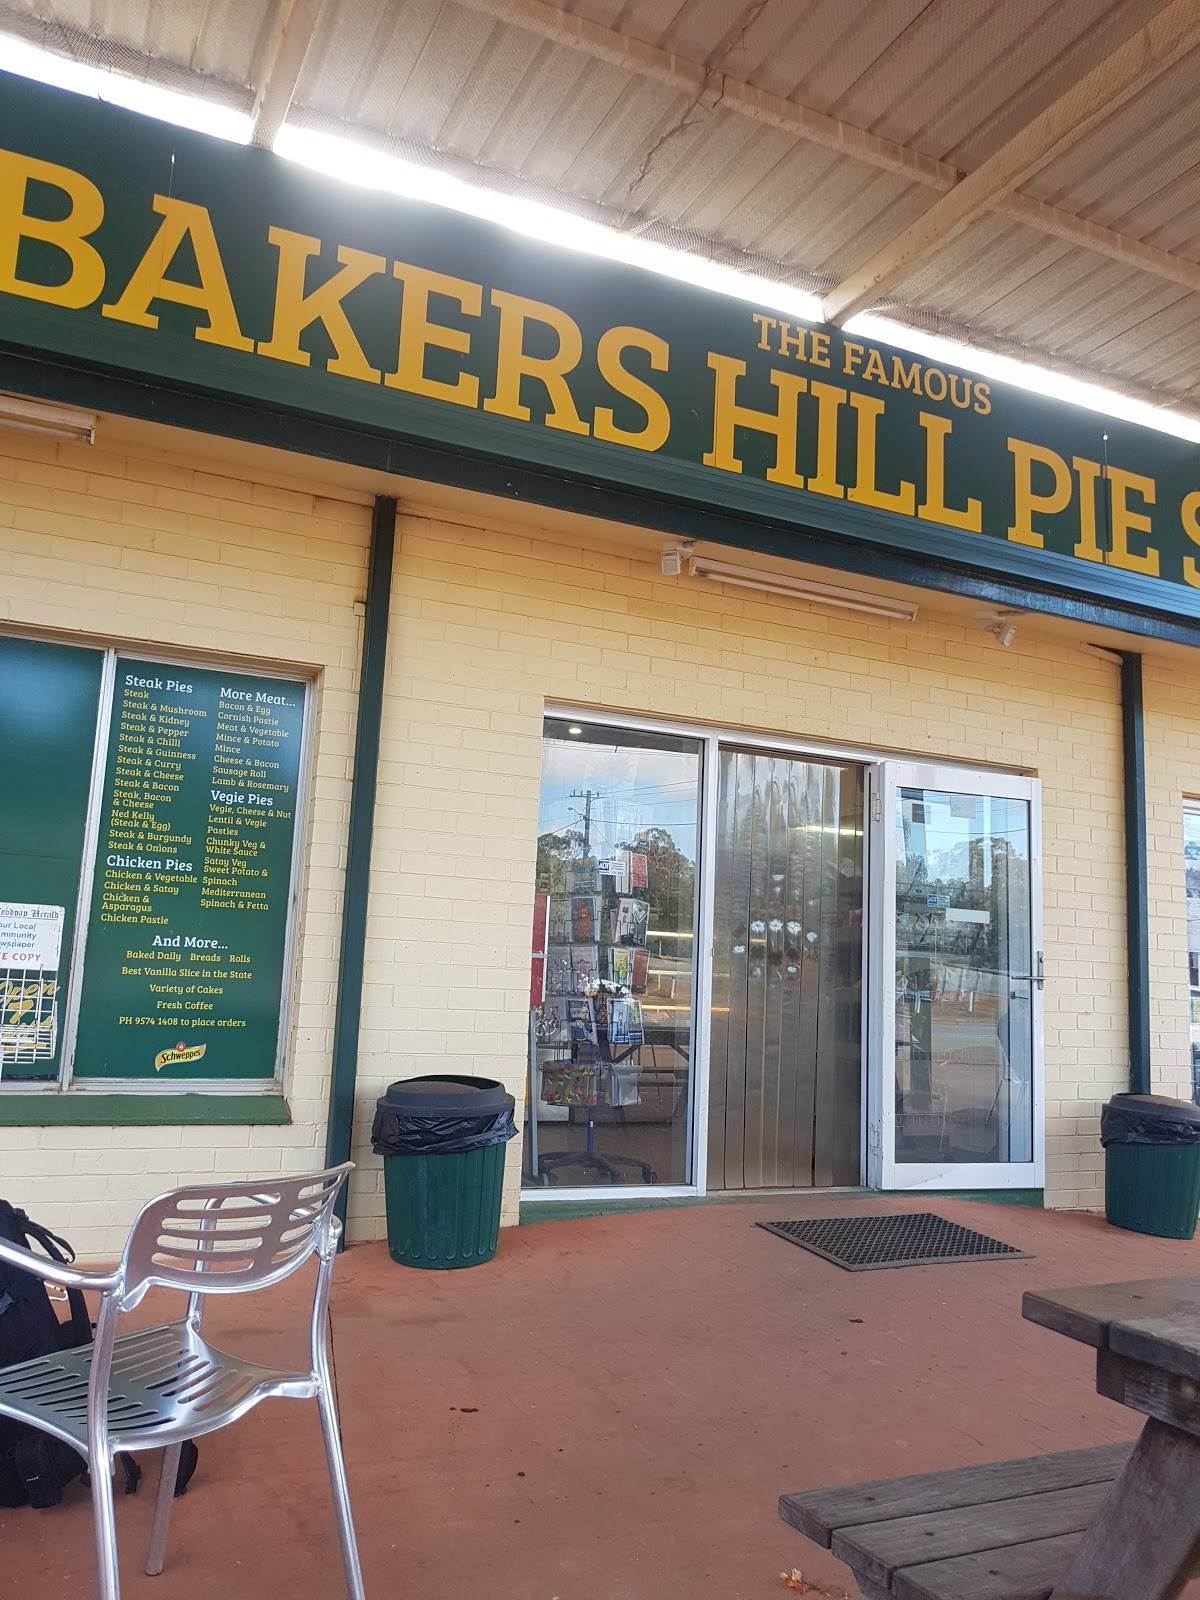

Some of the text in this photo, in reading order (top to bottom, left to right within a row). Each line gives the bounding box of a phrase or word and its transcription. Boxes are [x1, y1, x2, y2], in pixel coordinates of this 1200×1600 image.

[0, 149, 671, 452] BAKERS
[702, 352, 983, 534] HILL
[1006, 438, 1160, 577] PIE
[752, 313, 992, 415] THE FAMOUS
[125, 675, 193, 693] Steak Pies
[124, 689, 150, 699] Steak
[220, 688, 296, 707] More Meat...
[123, 700, 148, 710] Steak
[160, 705, 207, 717] Mushroom
[219, 701, 271, 715] Bacon & Egg
[122, 711, 190, 727] Steak & Kidney
[218, 712, 279, 725] Cornish Pastie
[120, 722, 146, 732] Steak
[158, 727, 189, 737] Pepper
[217, 723, 238, 732] Meat
[249, 726, 289, 738] Vegetable
[120, 734, 145, 744] Steak
[156, 738, 181, 747] Chilli
[216, 734, 242, 743] Mince
[252, 738, 279, 747] Potato
[118, 745, 144, 755] Steak
[155, 749, 197, 760] Guinness
[215, 744, 241, 754] Mince
[117, 756, 142, 766] Steak
[154, 760, 182, 771] Curry
[214, 755, 280, 769] Cheese & Bacon
[116, 767, 184, 781] Steak & Cheese
[213, 766, 266, 778] Sausage Roll
[115, 779, 140, 789] Steak
[152, 782, 180, 791] Bacon
[212, 777, 236, 786] Lamb
[248, 781, 289, 793] Rosemary
[114, 790, 172, 802] Steak, Bacon
[211, 790, 273, 806] Vegie Pies
[113, 798, 154, 809] & Cheese
[112, 810, 155, 822] Ned Kelly
[210, 804, 234, 815] Vegie,
[237, 808, 266, 816] Cheese
[110, 818, 139, 828] (Steak
[151, 821, 171, 832] Egg)
[208, 816, 233, 824] Lentil
[245, 818, 267, 828] Vegie
[109, 830, 192, 844] Steak & Burgundy
[208, 826, 238, 836] Pasties
[108, 841, 134, 850] Steak
[146, 844, 178, 853] Onions
[206, 837, 240, 848] Chunky
[242, 840, 257, 850] Veg
[206, 846, 258, 856] White Sauce
[107, 855, 193, 871] Chicken Pies
[204, 857, 247, 868] Satay Veg
[105, 870, 142, 880] Chicken
[155, 873, 198, 884] Vegetable
[204, 866, 229, 874] Sweet
[231, 867, 260, 876] Potato
[203, 877, 238, 886] Spinach
[104, 881, 141, 891] Chicken
[153, 884, 179, 895] Satay
[202, 888, 266, 899] Mediterranean
[103, 893, 140, 902] Chicken
[102, 902, 152, 913] Asparagus
[200, 899, 269, 910] Spinach & Fetta
[101, 914, 169, 924] Chicken Pastie
[14, 922, 36, 930] Local
[152, 935, 228, 949] And More...
[12, 953, 41, 961] COPY
[126, 951, 251, 963] Baked Daily Breads Rolls
[122, 967, 252, 979] Best Vanilla Slice in the State
[149, 984, 223, 994] Variety of Cakes
[157, 1001, 213, 1010] Fresh Coffee
[118, 1017, 246, 1028] PH 9574 1408 to place orders
[160, 1049, 201, 1064] Schweppes
